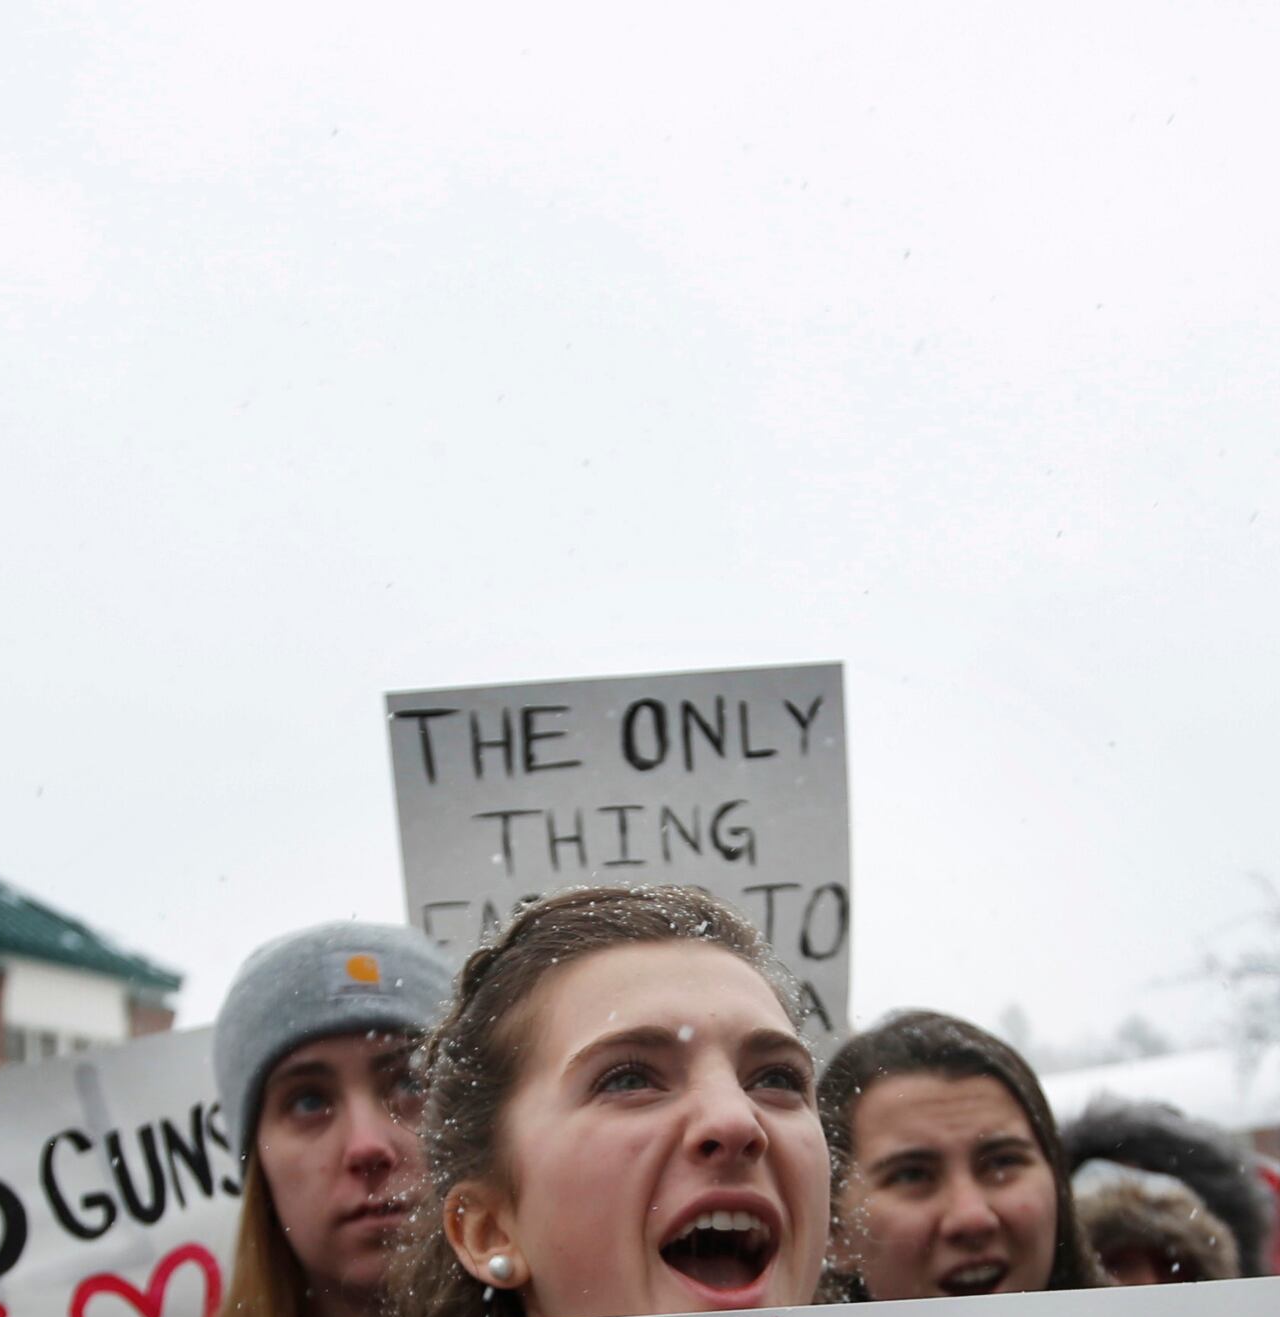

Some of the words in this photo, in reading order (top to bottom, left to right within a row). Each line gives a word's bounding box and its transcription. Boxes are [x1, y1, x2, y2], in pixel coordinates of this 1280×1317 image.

[394, 705, 581, 785] THE
[623, 694, 824, 773] ONLY
[472, 798, 757, 877] THING
[742, 881, 851, 960] TO
